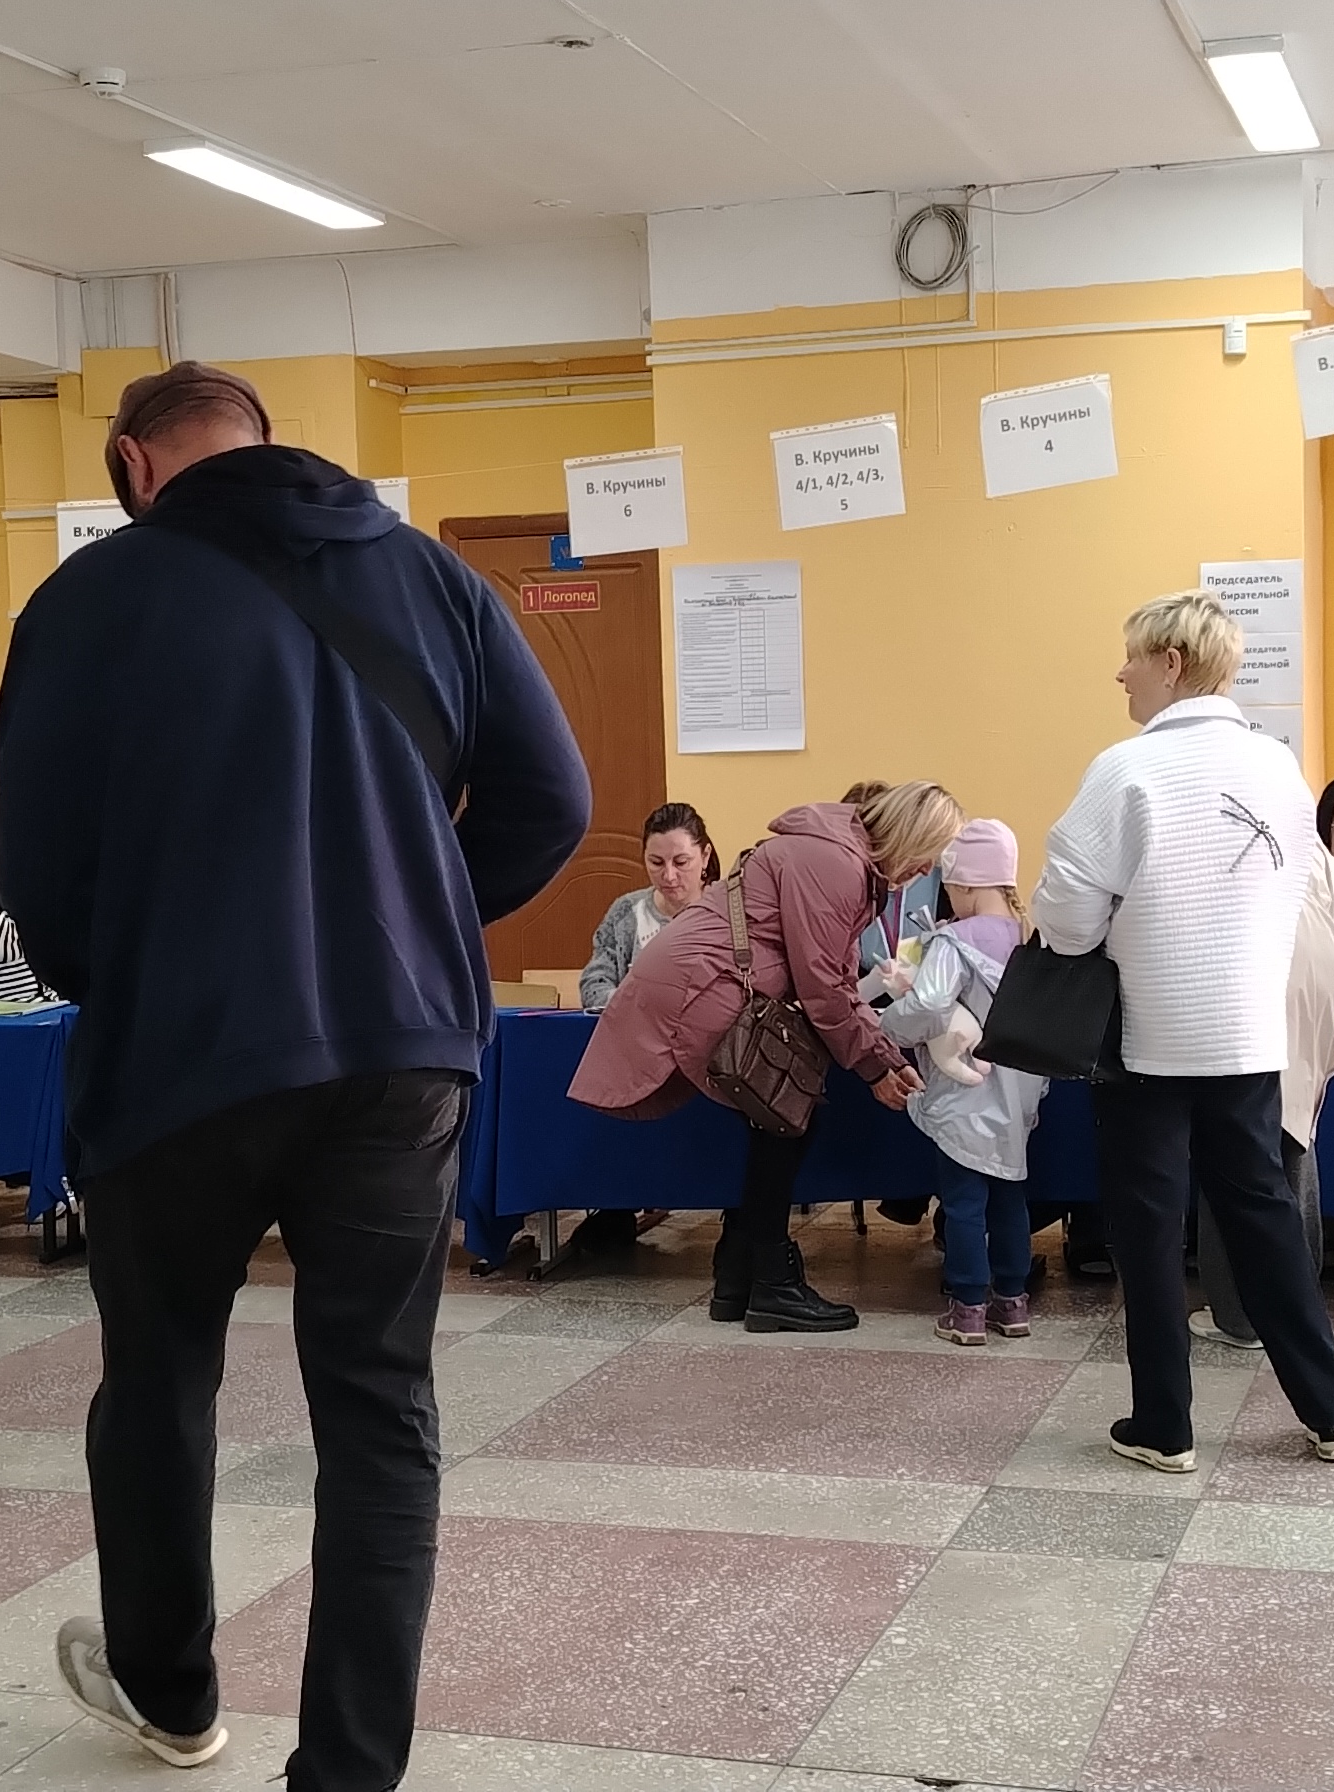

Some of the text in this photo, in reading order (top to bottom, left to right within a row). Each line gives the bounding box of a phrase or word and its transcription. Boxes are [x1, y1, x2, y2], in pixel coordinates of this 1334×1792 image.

[1317, 357, 1334, 371] В.
[1000, 407, 1091, 432] В. Кручины
[1044, 439, 1054, 452] 4
[794, 444, 880, 466] В. Кручины
[586, 476, 666, 495] В. Кручины
[795, 468, 884, 494] 4/1, 4/2, 4/3,
[624, 504, 632, 517] 6
[840, 499, 849, 511] 5
[73, 526, 116, 538] В.Кру
[1207, 575, 1283, 586] Председатель
[526, 589, 596, 607] 1 Логопед
[1219, 589, 1289, 601] бирательной
